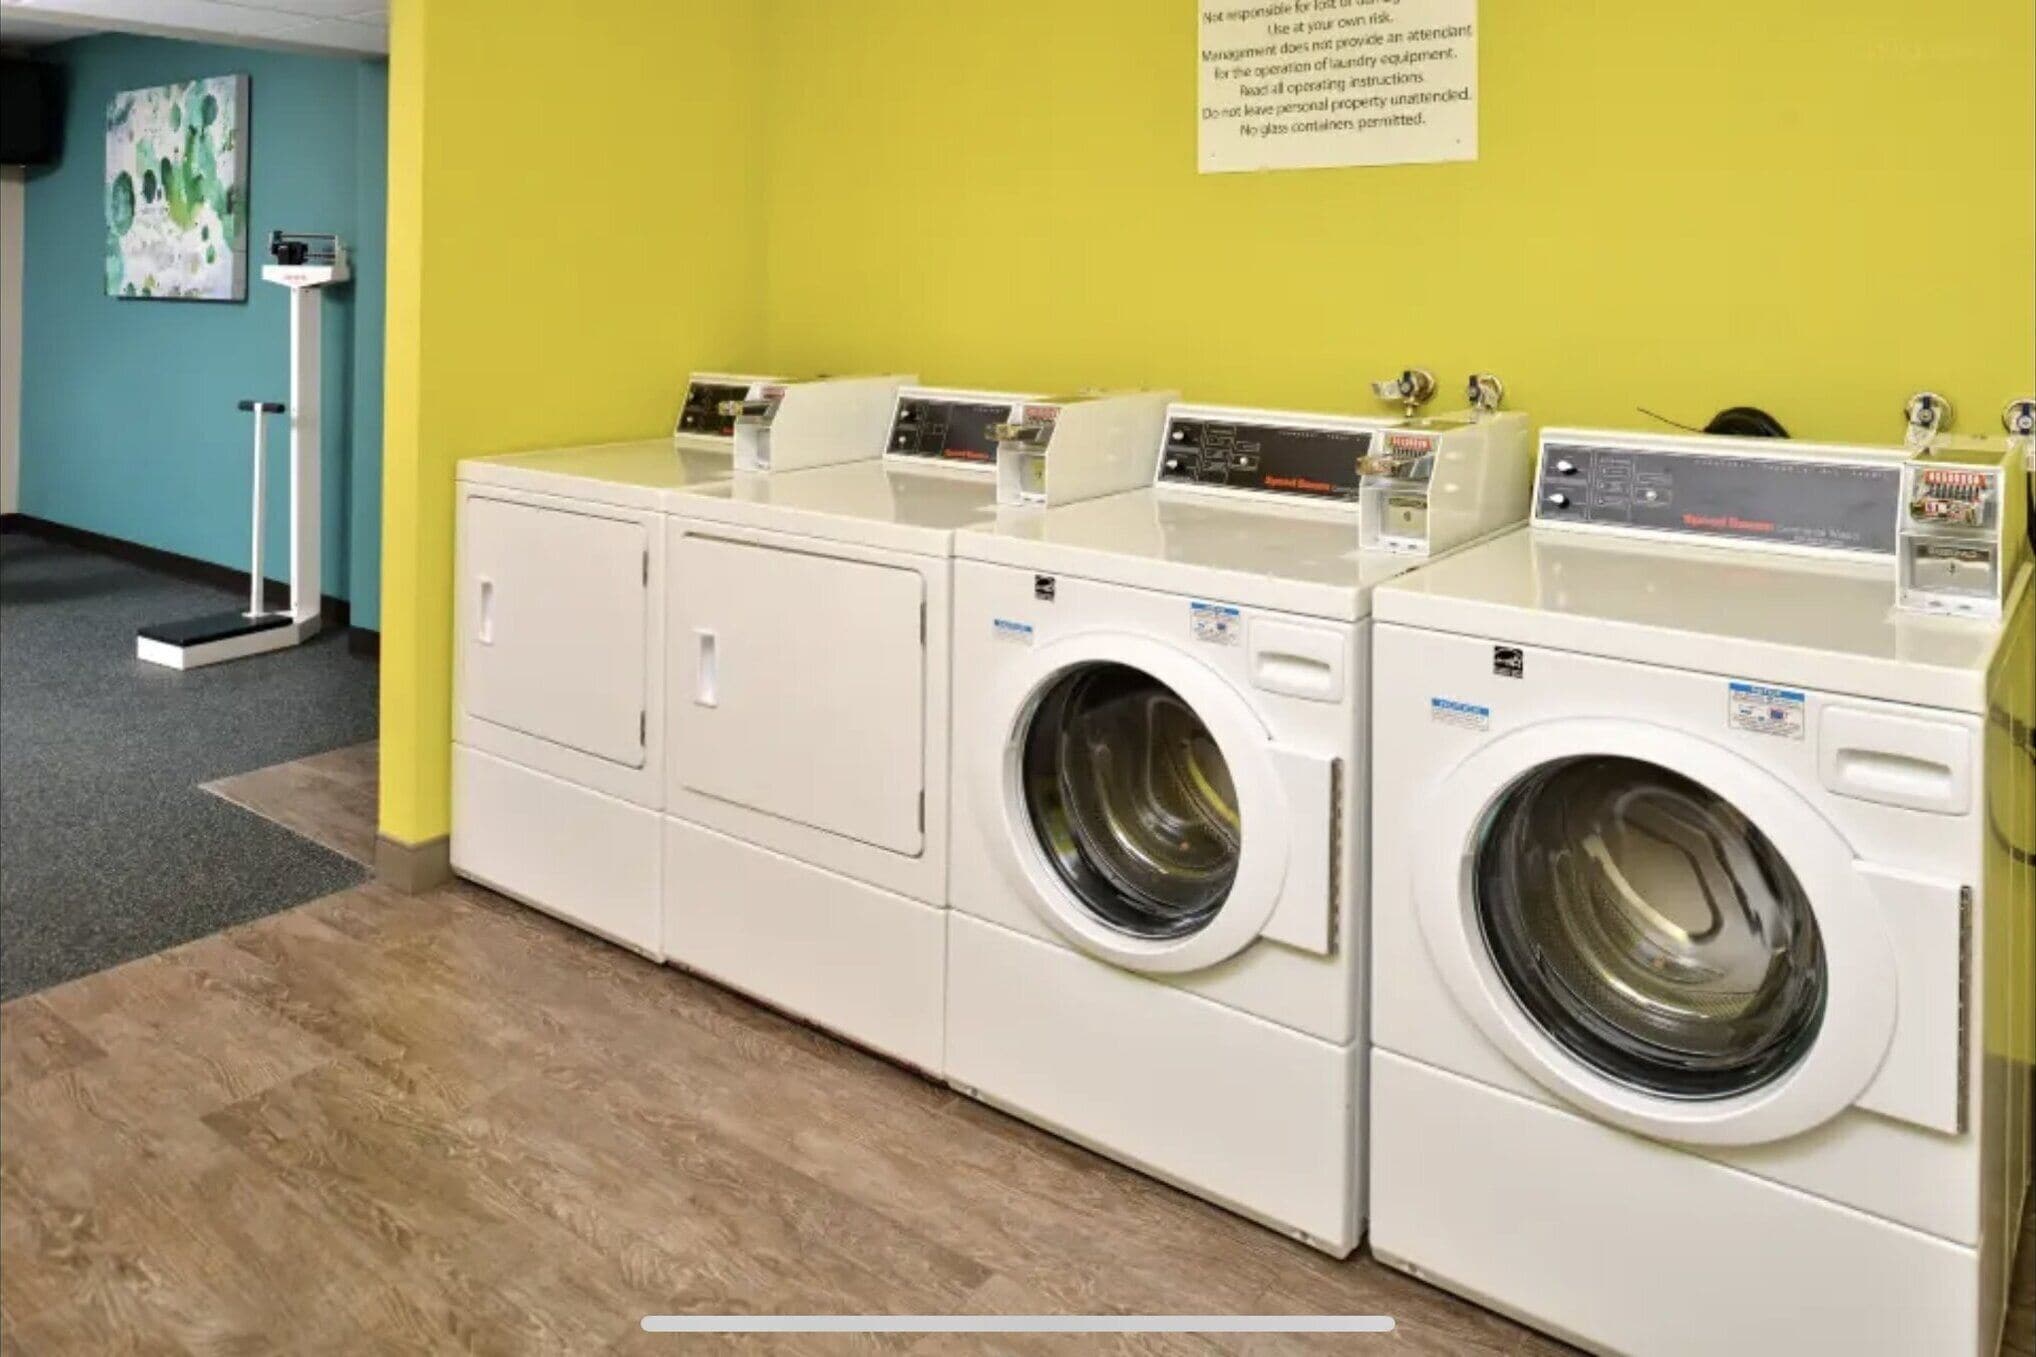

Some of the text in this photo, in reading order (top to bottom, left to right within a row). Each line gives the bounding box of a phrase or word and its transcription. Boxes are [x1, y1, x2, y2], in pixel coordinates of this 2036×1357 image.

[1295, 0, 1311, 12] for
[1267, 11, 1393, 34] Use at your own risk.
[1202, 24, 1472, 62] Management does not provide an attendant
[1214, 47, 1458, 79] for the operation of laundry equipment.
[1240, 84, 1268, 97] Read
[1271, 81, 1284, 94] all
[1287, 78, 1345, 96] operating
[1202, 107, 1220, 120] Do
[1222, 106, 1242, 118] not
[1244, 103, 1274, 116] leave
[1276, 97, 1328, 116] personal
[1331, 95, 1387, 112] property
[1240, 112, 1425, 138] No glass containers permitted.
